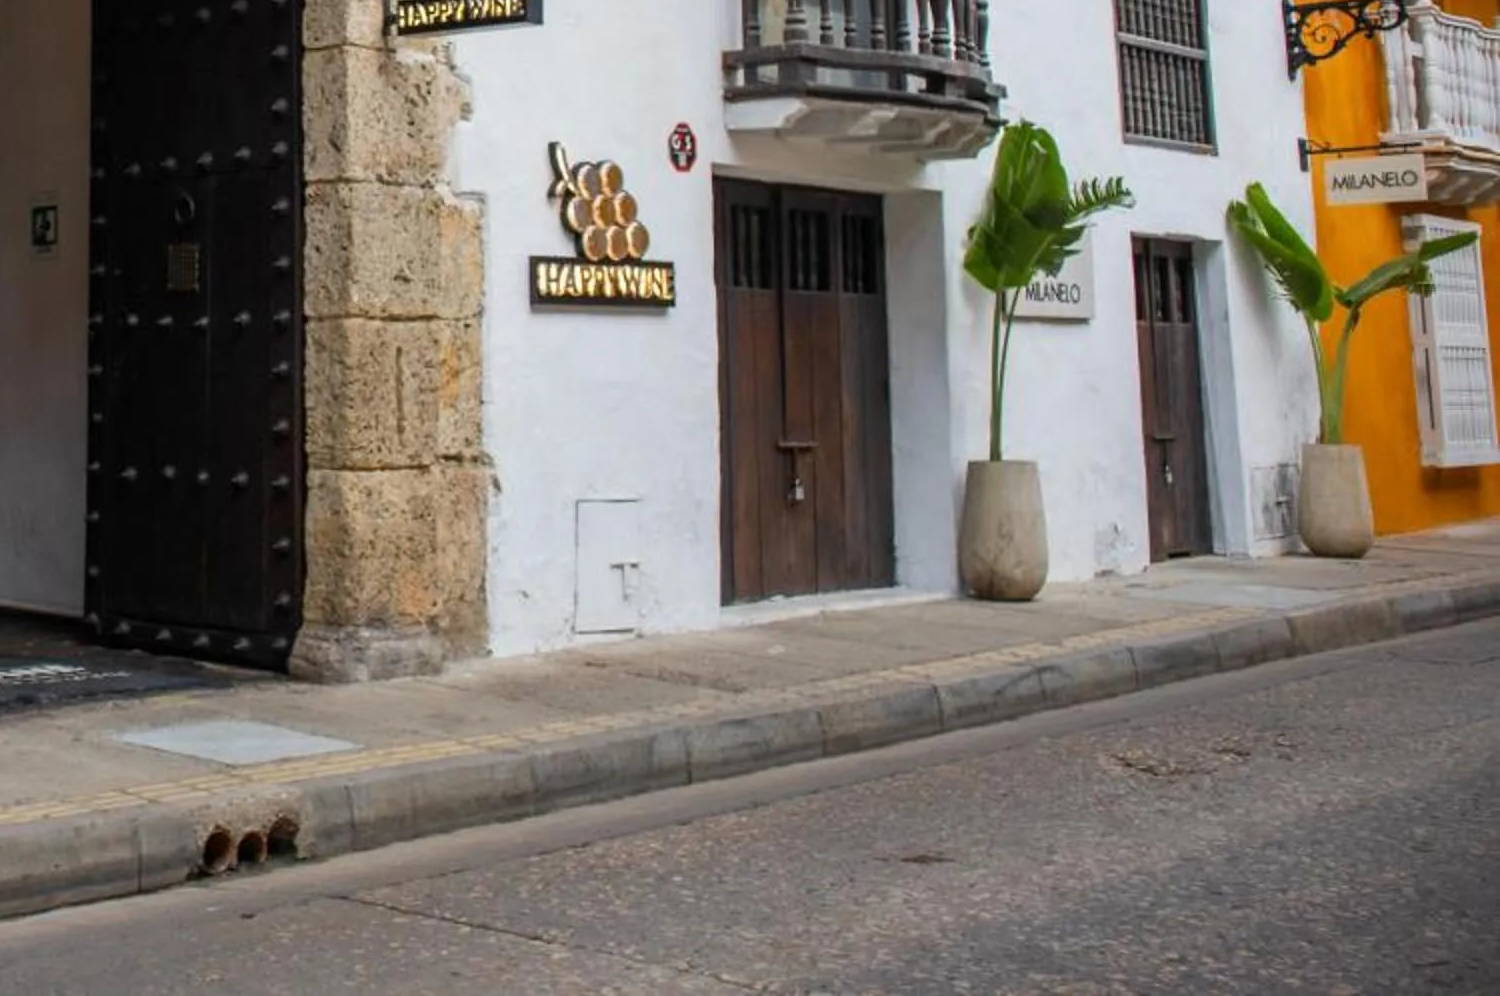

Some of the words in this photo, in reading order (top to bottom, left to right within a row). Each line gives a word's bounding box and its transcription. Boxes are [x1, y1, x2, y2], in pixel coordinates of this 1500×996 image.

[1332, 170, 1418, 191] MILANELO
[537, 263, 616, 297] HAPPY
[617, 265, 674, 300] WINE
[1025, 282, 1081, 304] MILANELO
